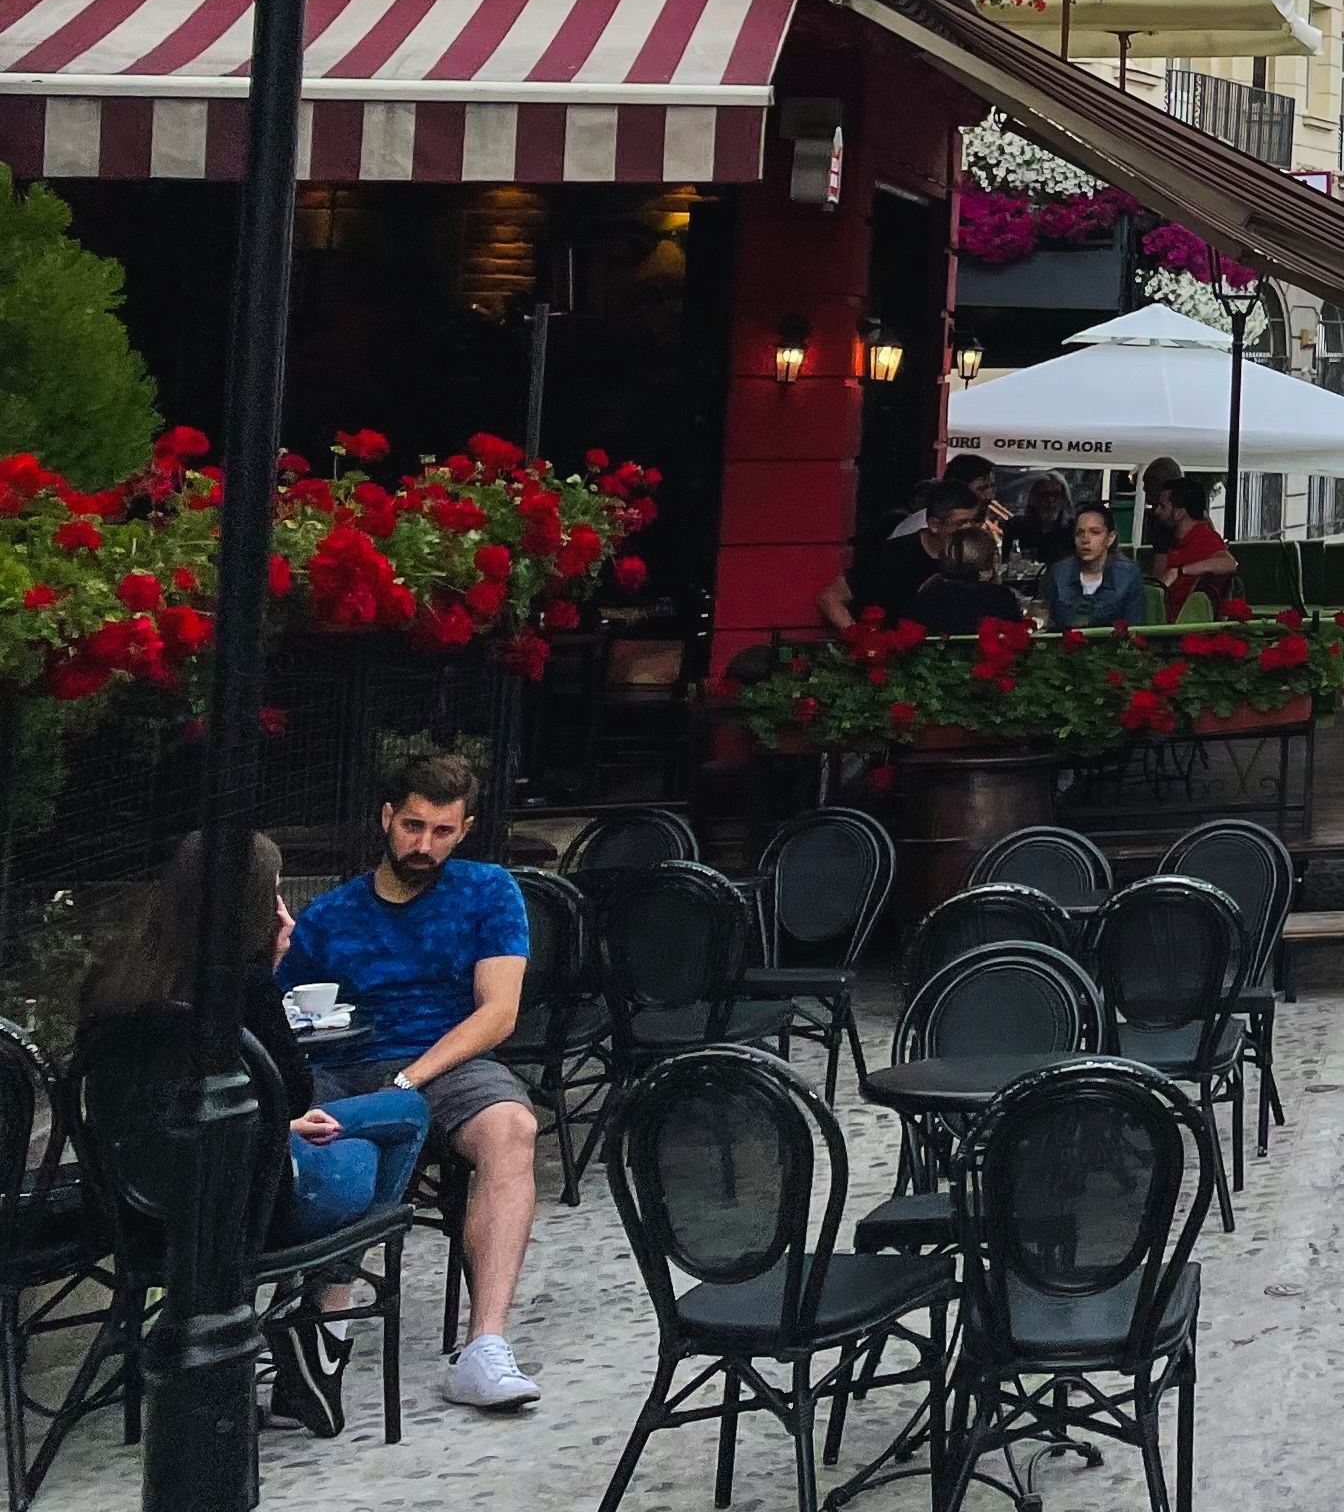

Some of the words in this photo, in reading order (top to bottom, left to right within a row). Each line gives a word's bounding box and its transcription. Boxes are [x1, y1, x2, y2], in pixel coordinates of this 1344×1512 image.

[994, 438, 1037, 450] OPEN
[1042, 439, 1063, 451] TO
[1067, 440, 1113, 453] MORE
